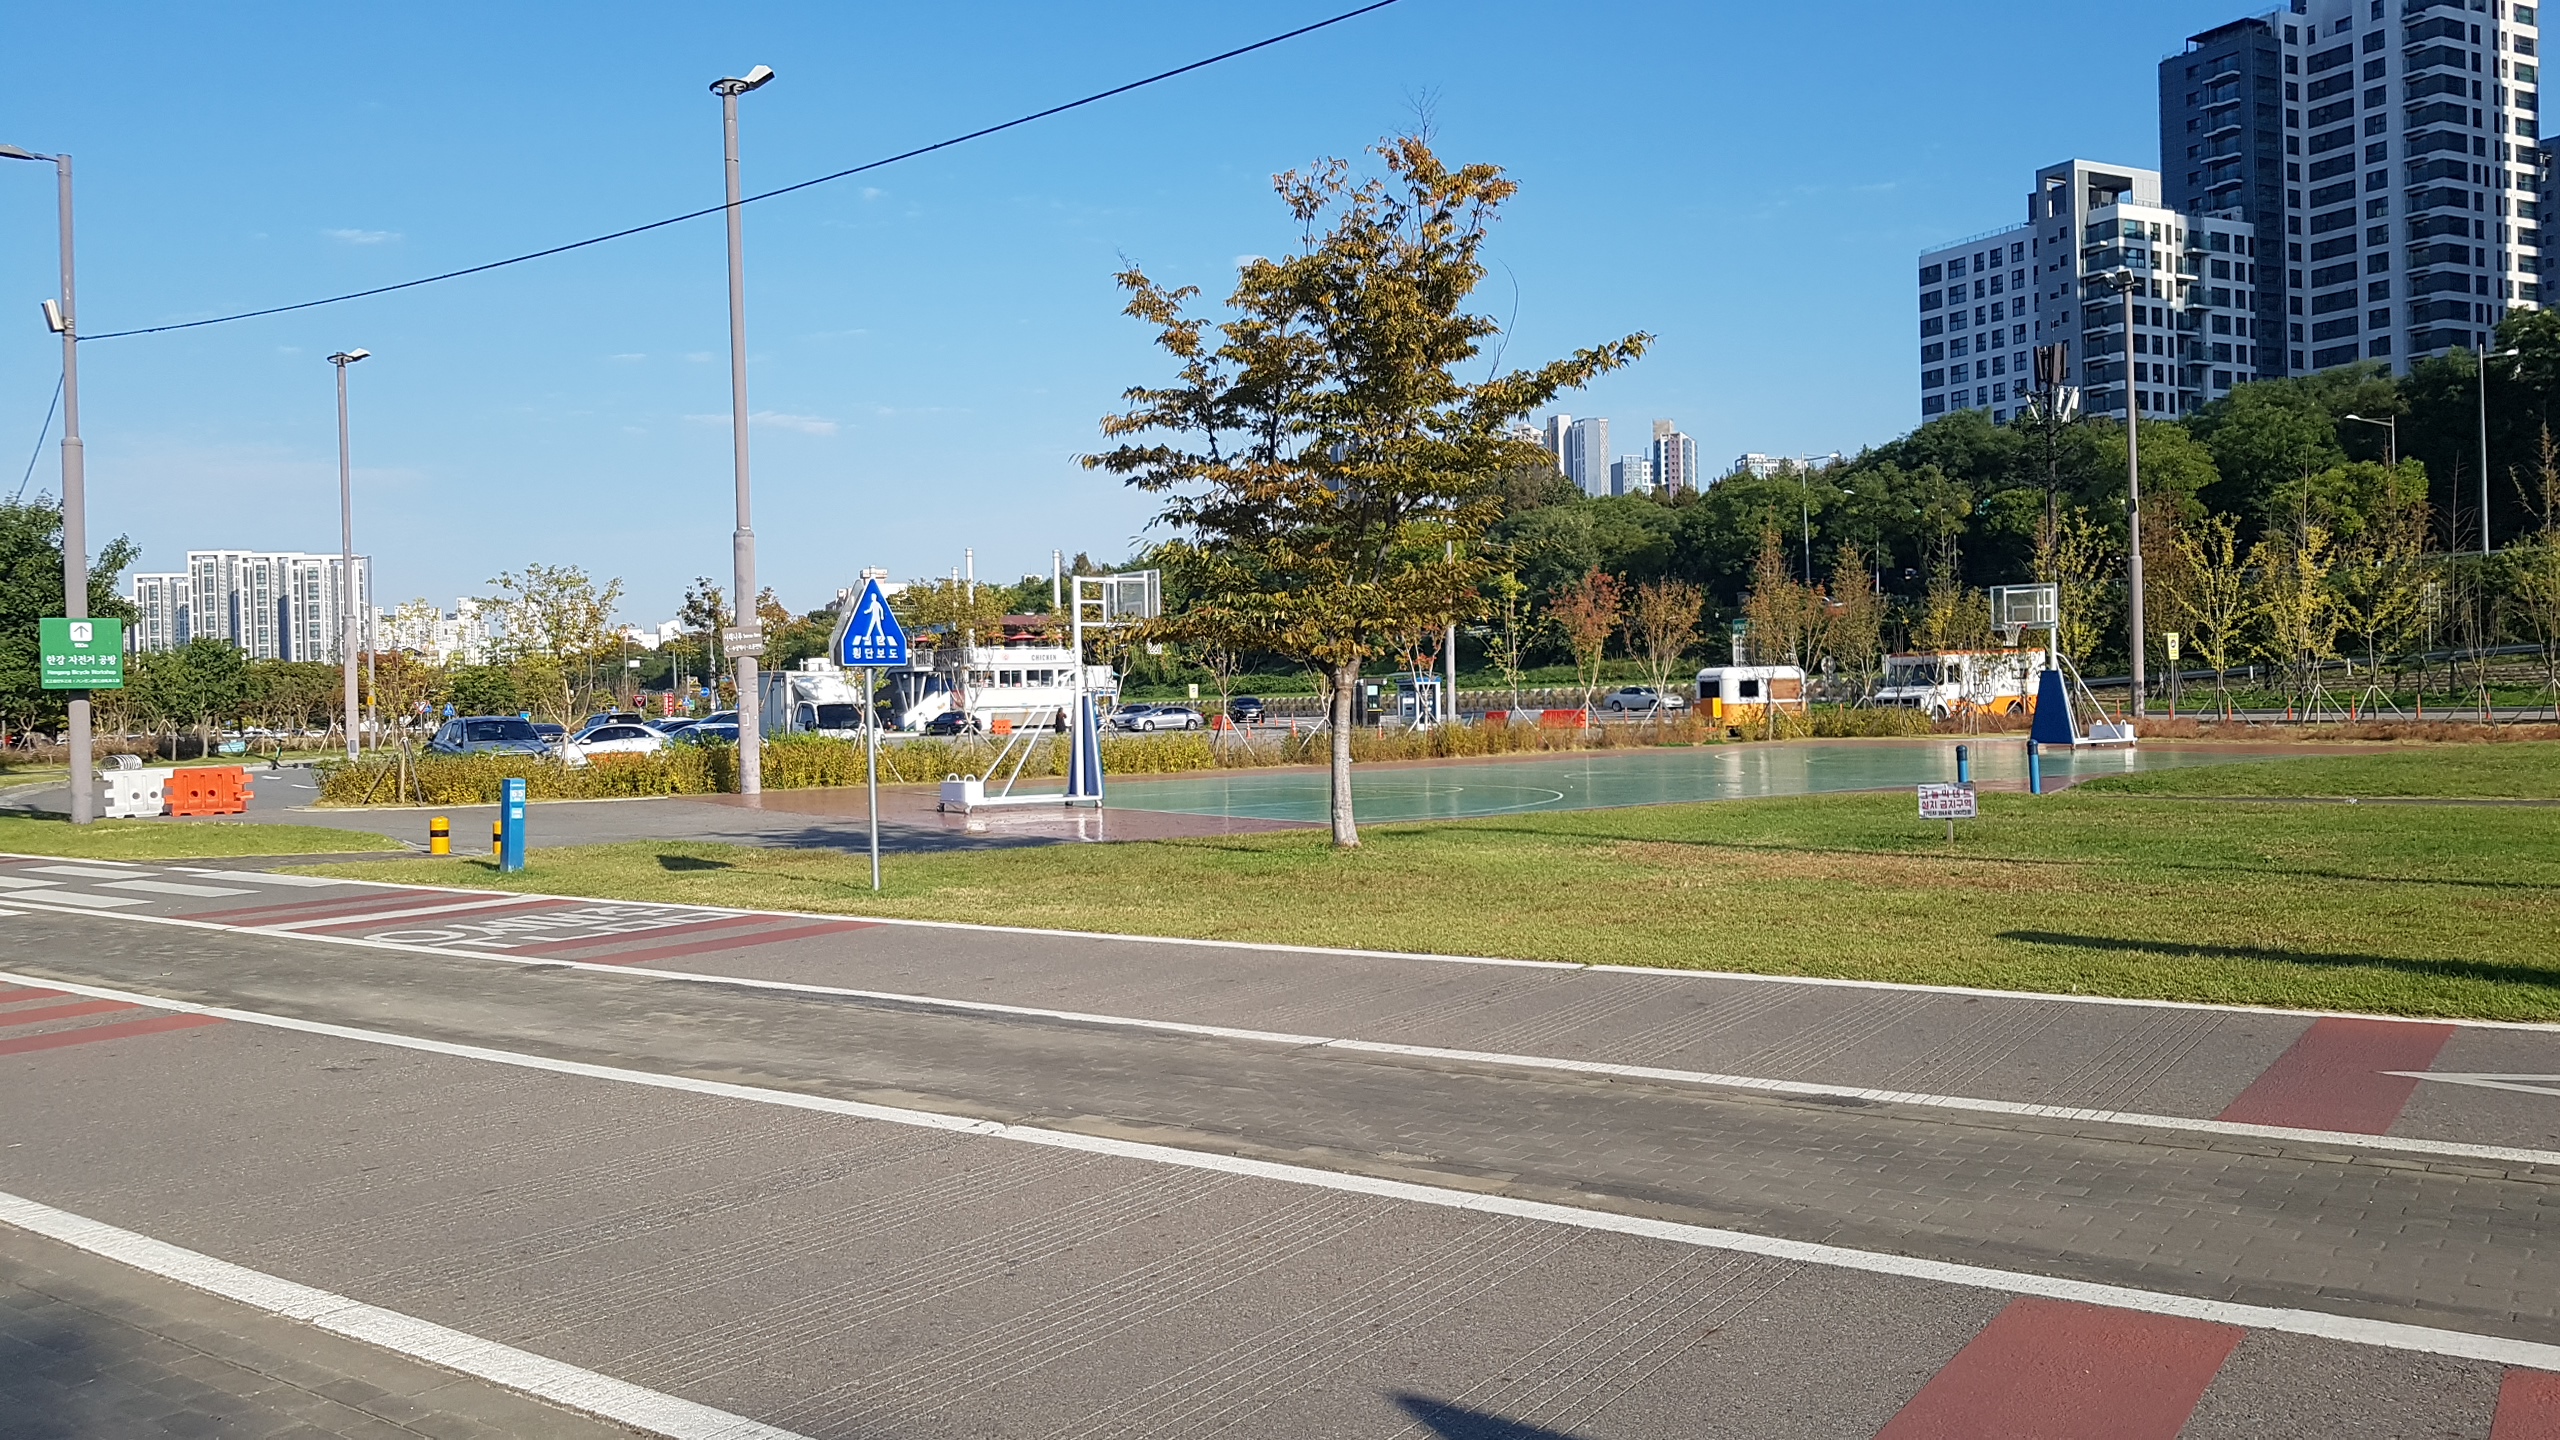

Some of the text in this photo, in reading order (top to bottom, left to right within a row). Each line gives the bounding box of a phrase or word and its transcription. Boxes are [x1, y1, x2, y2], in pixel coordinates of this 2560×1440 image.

[852, 647, 899, 659] 횡단보도
[46, 654, 117, 666] 한강 자전거 공방
